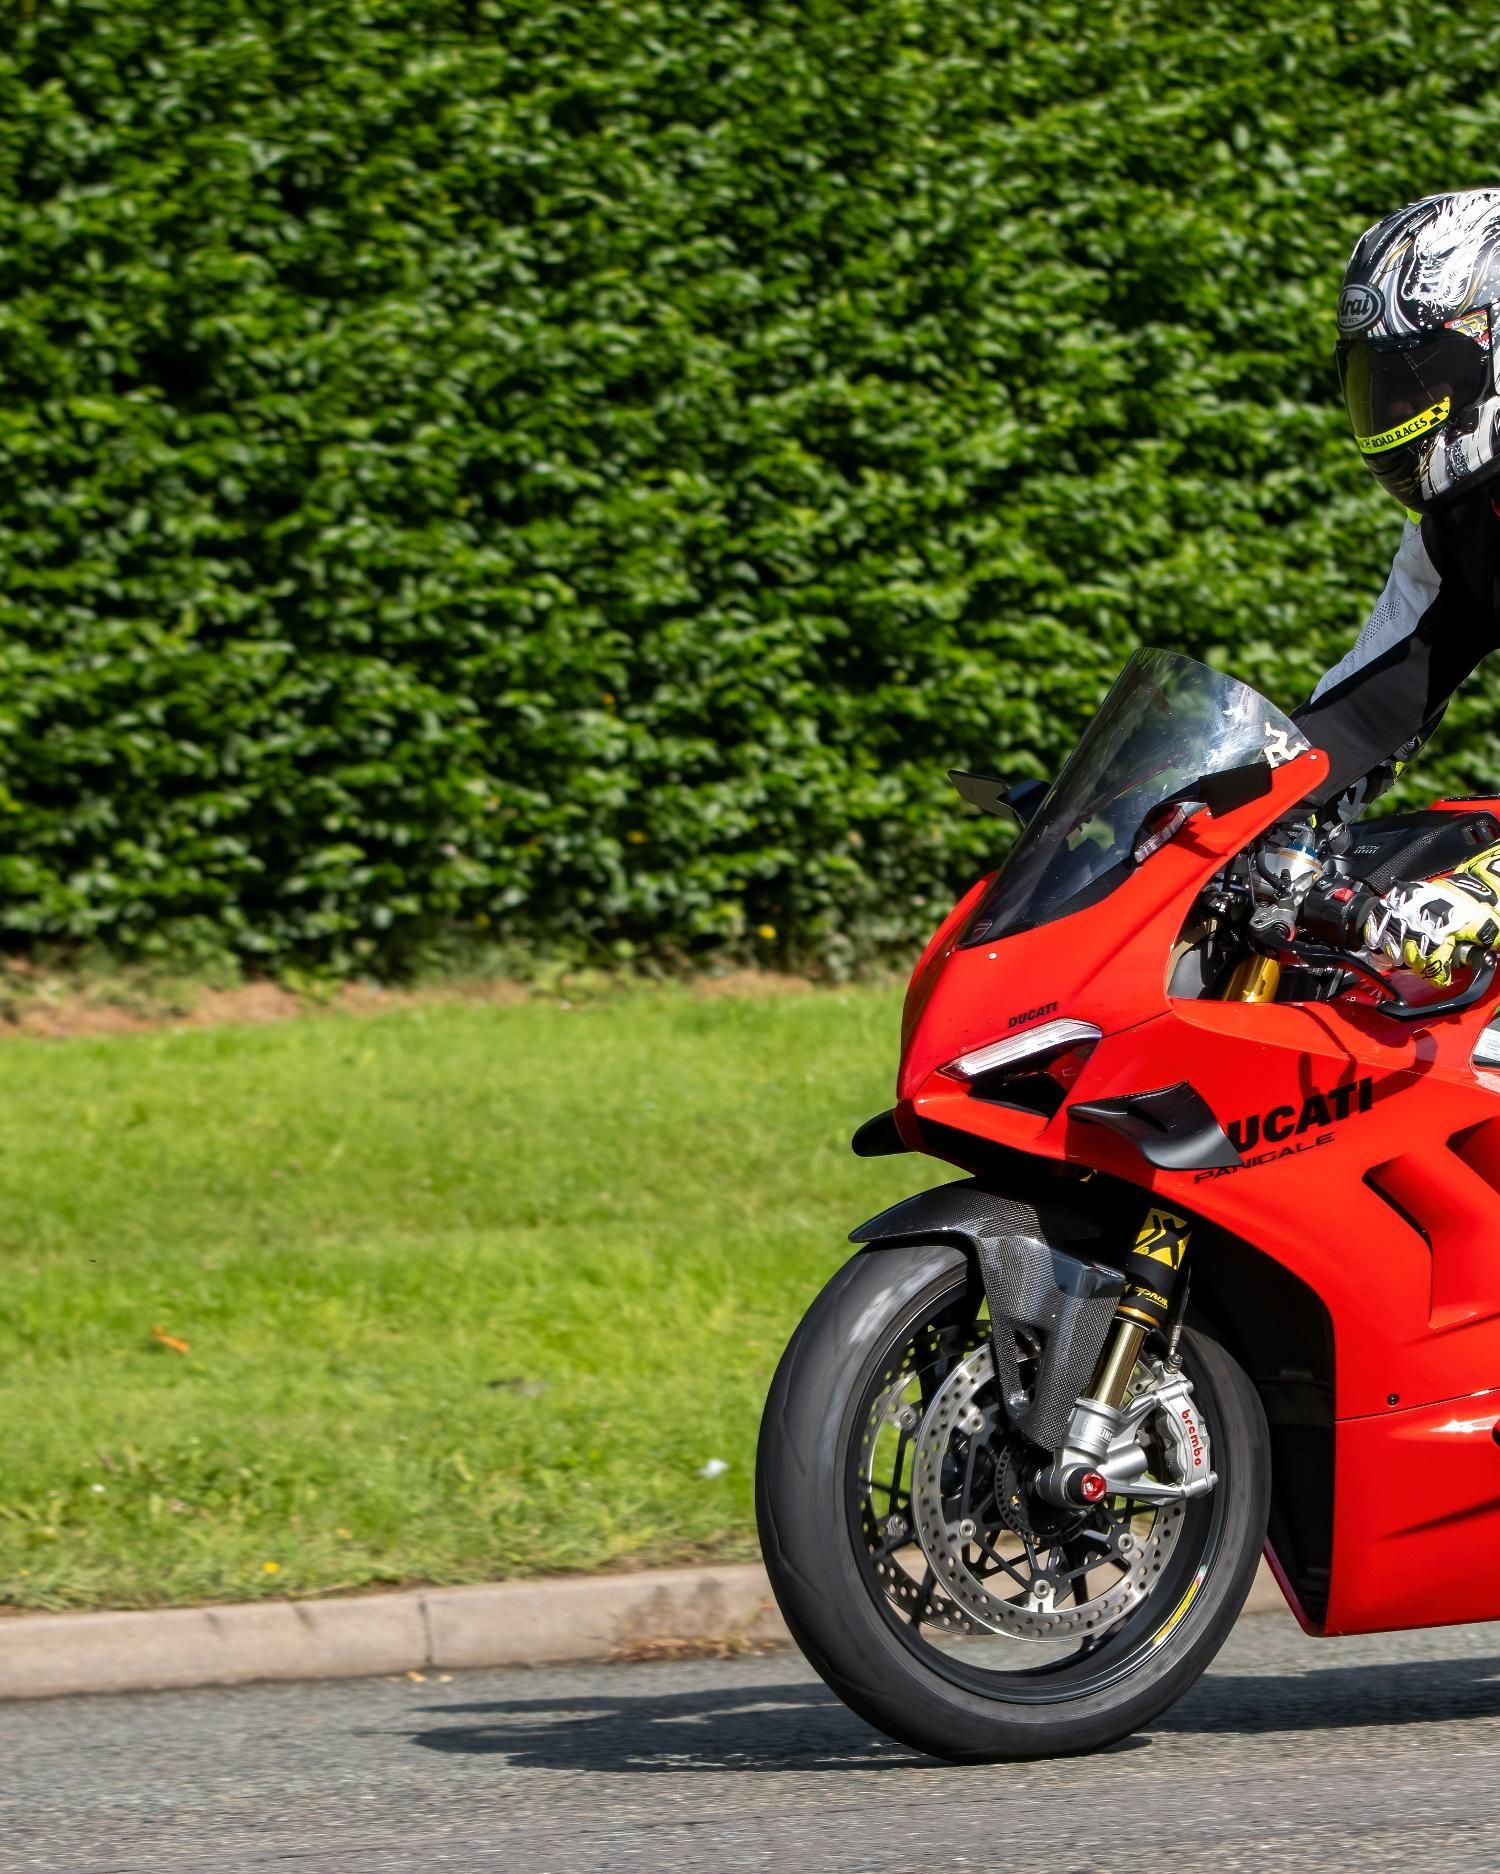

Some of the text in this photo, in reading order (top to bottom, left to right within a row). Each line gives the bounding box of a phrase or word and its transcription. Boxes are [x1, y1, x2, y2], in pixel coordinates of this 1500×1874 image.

[1372, 417, 1428, 448] ROAD RACES
[1008, 1001, 1058, 1028] DUCATI
[1227, 1076, 1373, 1154] UCATI
[1181, 1408, 1204, 1467] brembo
